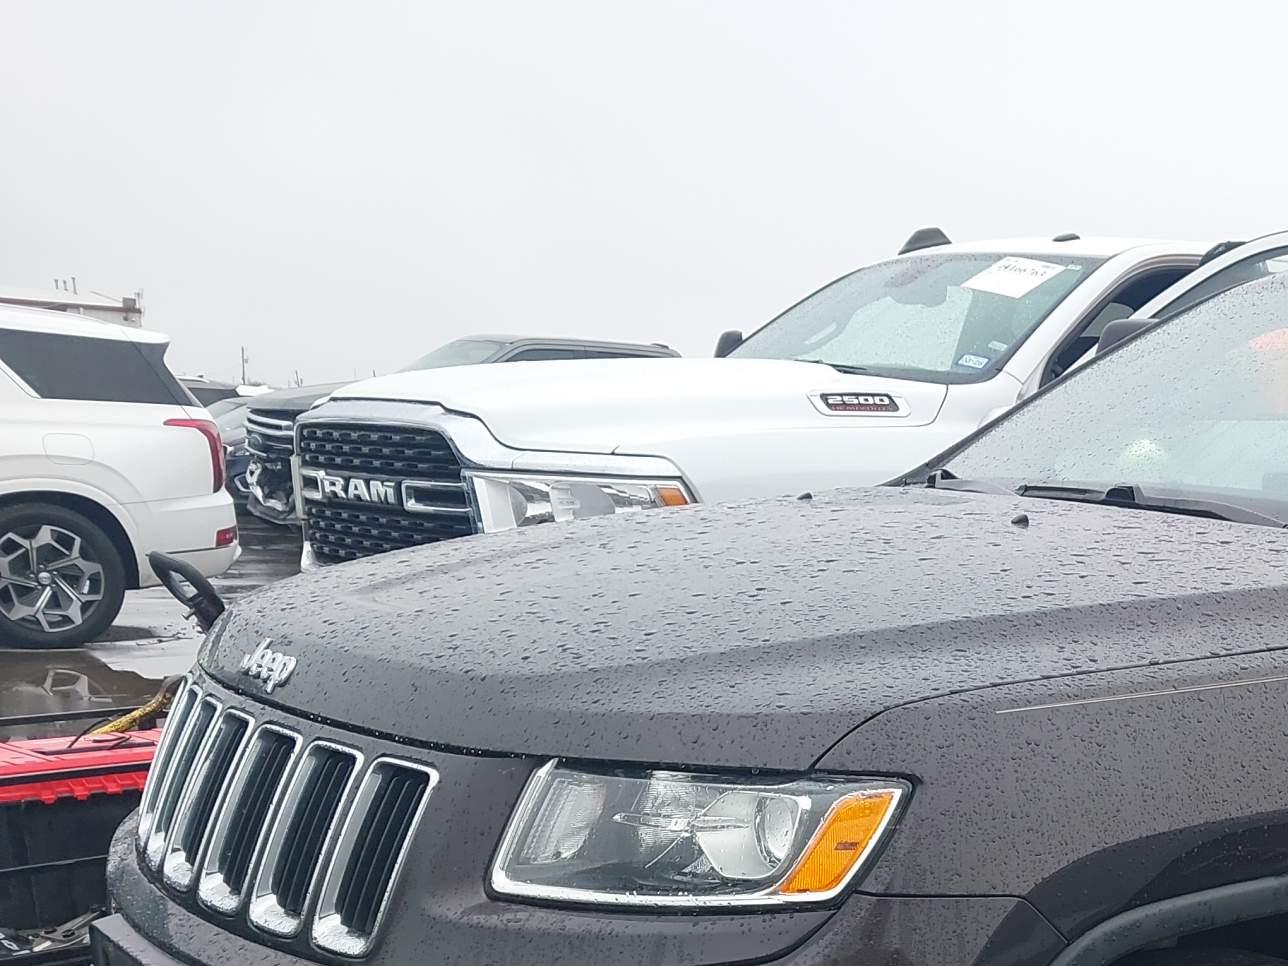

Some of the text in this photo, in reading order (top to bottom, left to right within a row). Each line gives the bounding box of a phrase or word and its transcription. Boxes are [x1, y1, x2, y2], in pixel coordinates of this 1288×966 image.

[826, 395, 890, 405] 2500
[322, 475, 397, 504] RAM
[239, 637, 298, 695] Jeep
